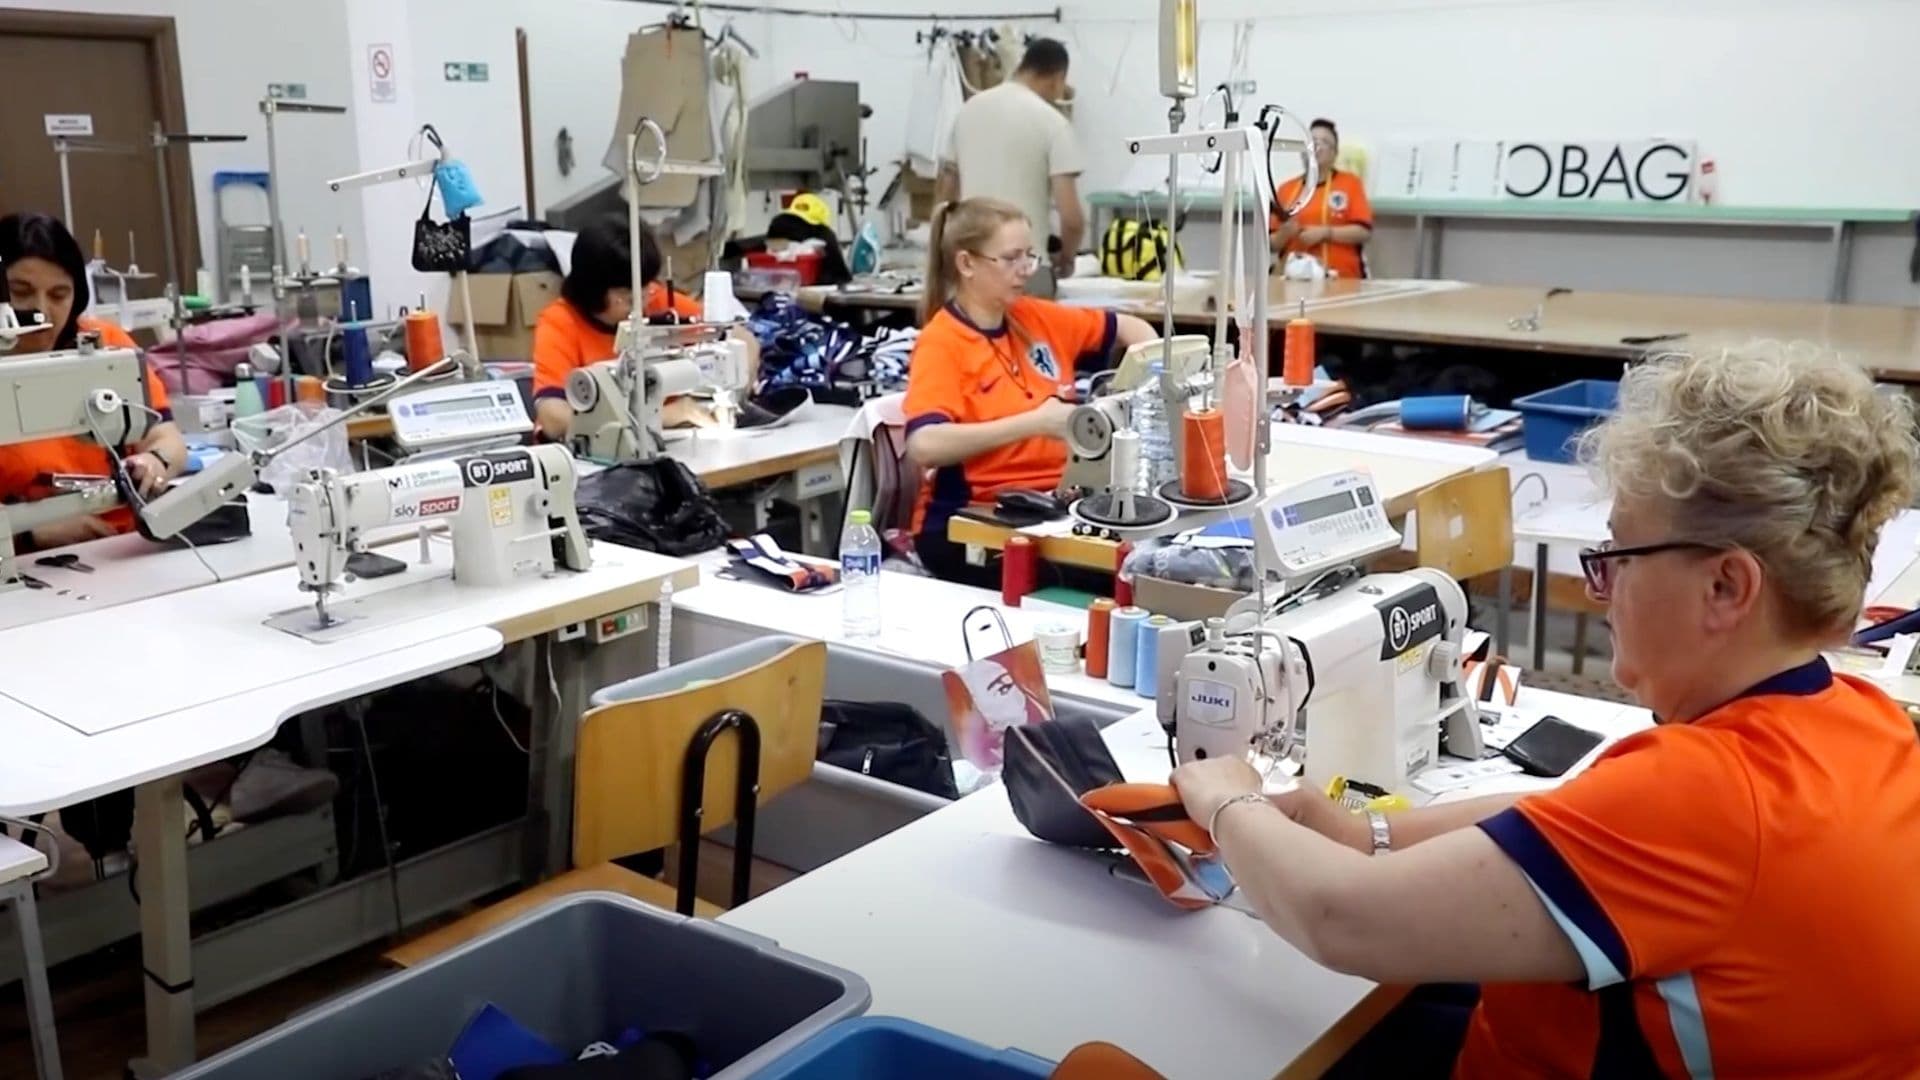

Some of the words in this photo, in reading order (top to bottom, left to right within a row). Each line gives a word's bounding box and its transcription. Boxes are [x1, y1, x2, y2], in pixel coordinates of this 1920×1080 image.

[472, 464, 488, 478] BT
[494, 459, 528, 474] SPORT
[394, 504, 416, 517] sky
[421, 499, 458, 514] sport
[1410, 604, 1437, 631] SPORT
[1191, 694, 1230, 707] JUKI
